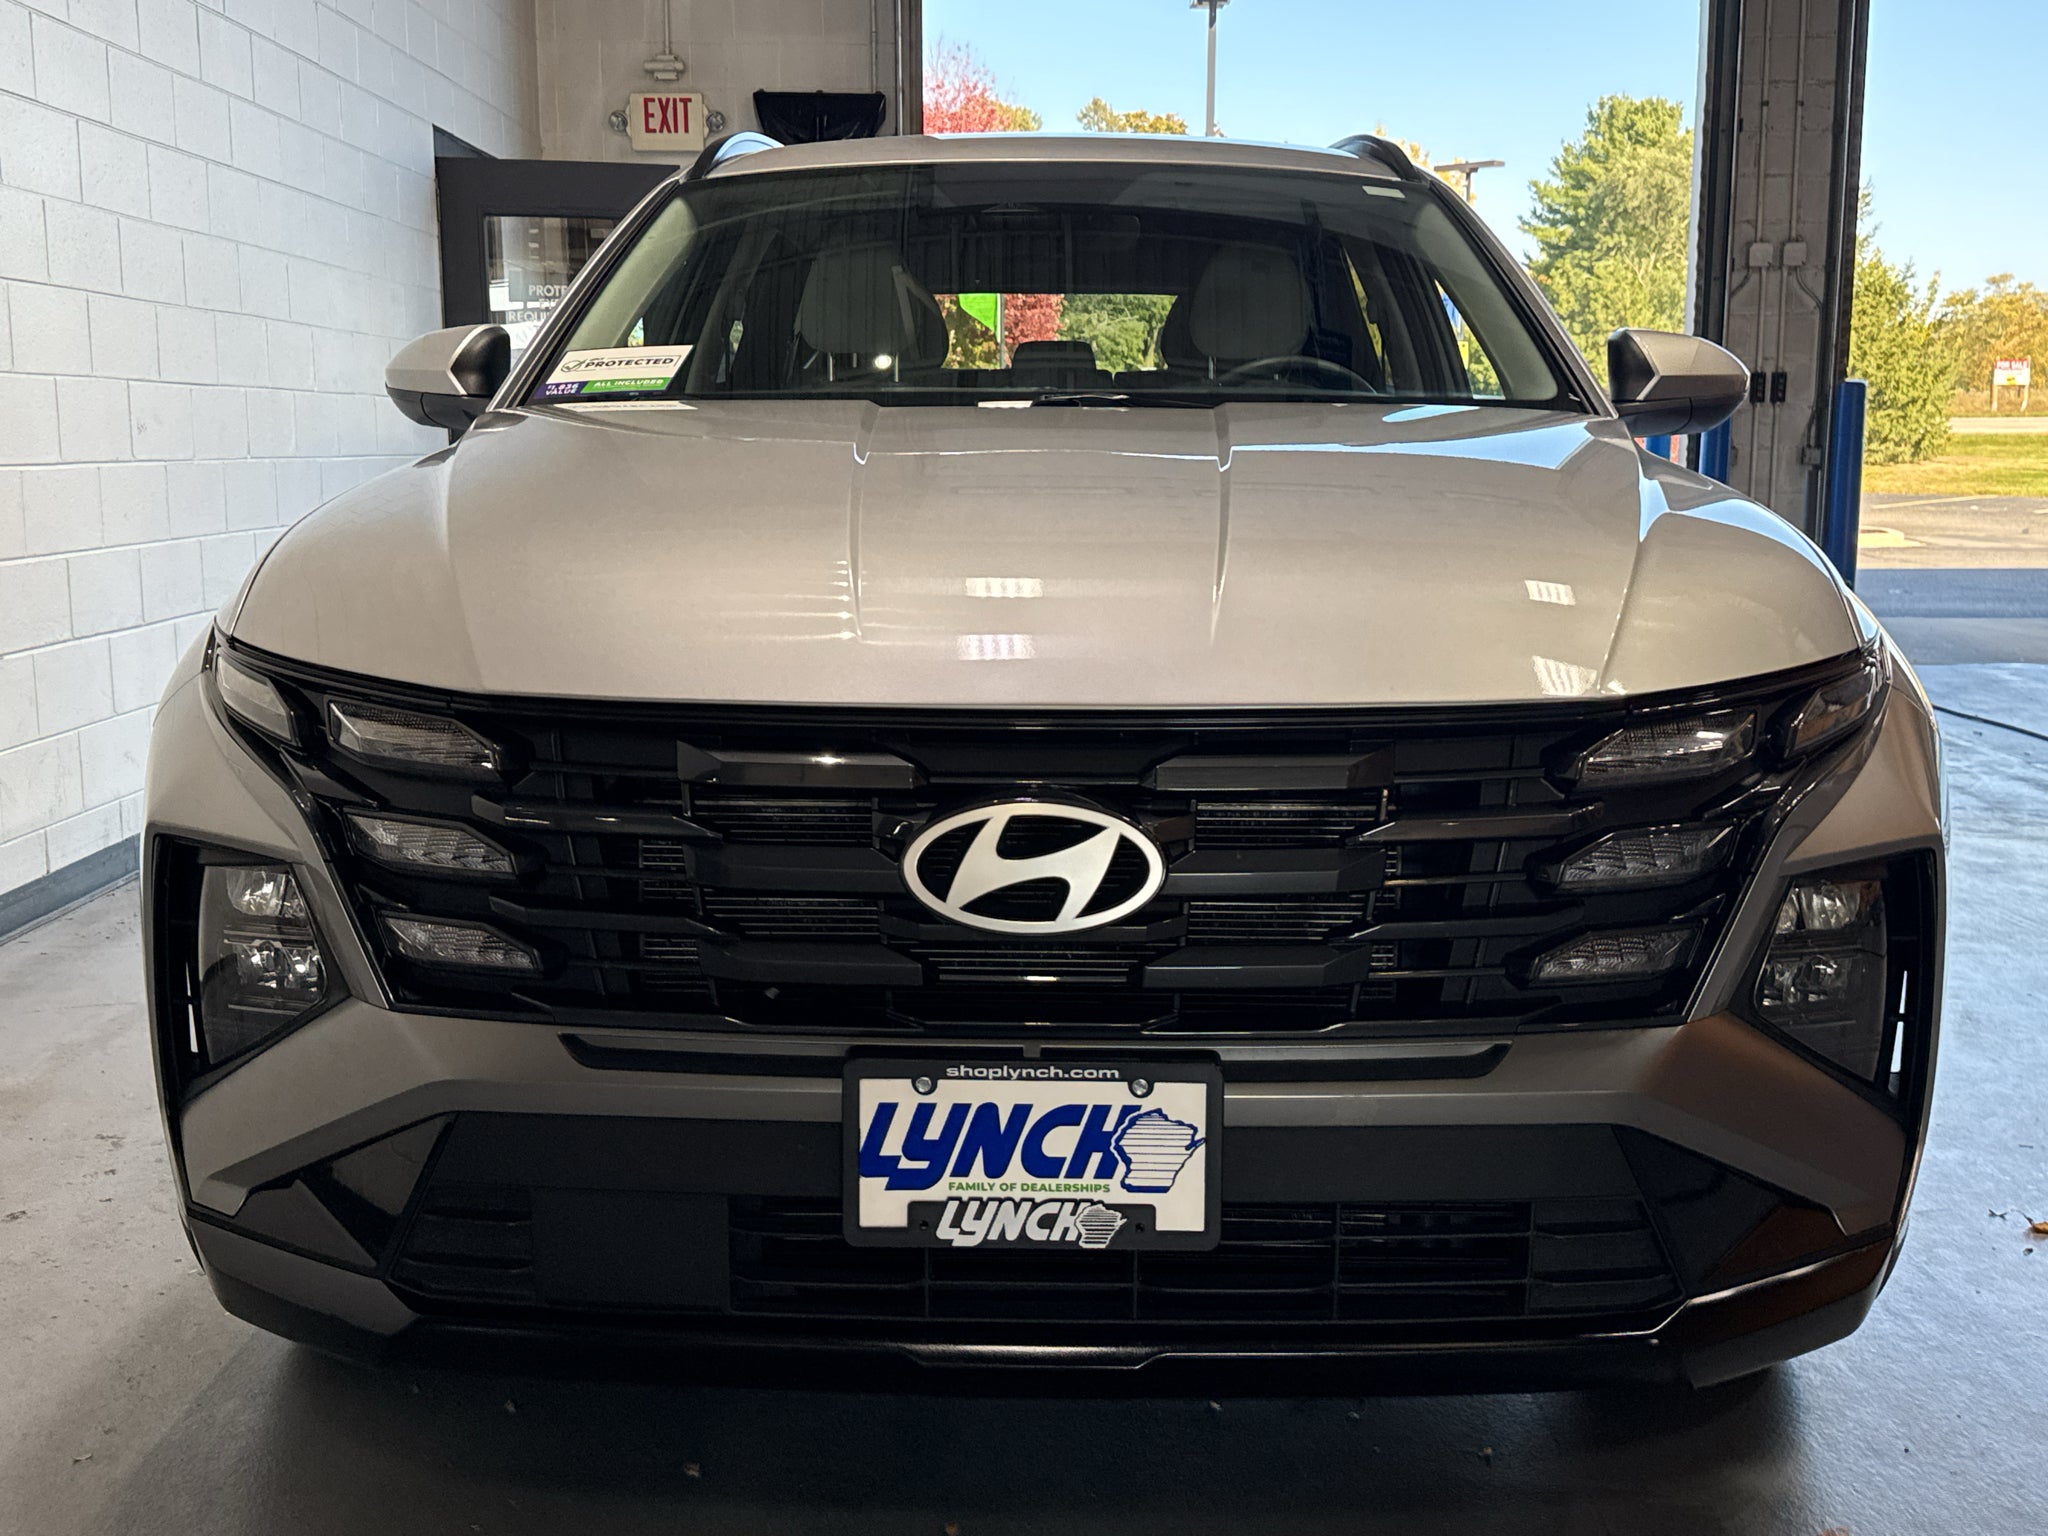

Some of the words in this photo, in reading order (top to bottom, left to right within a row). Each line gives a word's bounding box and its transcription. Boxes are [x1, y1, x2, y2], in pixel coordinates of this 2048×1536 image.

[643, 97, 692, 134] EXIT
[584, 357, 674, 369] PROTECTED
[945, 1065, 1120, 1081] shoplynch.com
[859, 1101, 1142, 1191] LYNCH
[948, 1181, 996, 1192] FAMILY
[999, 1181, 1018, 1192] OF
[1020, 1182, 1111, 1193] DEALERSHIPS
[936, 1199, 1091, 1247] LYNCH
